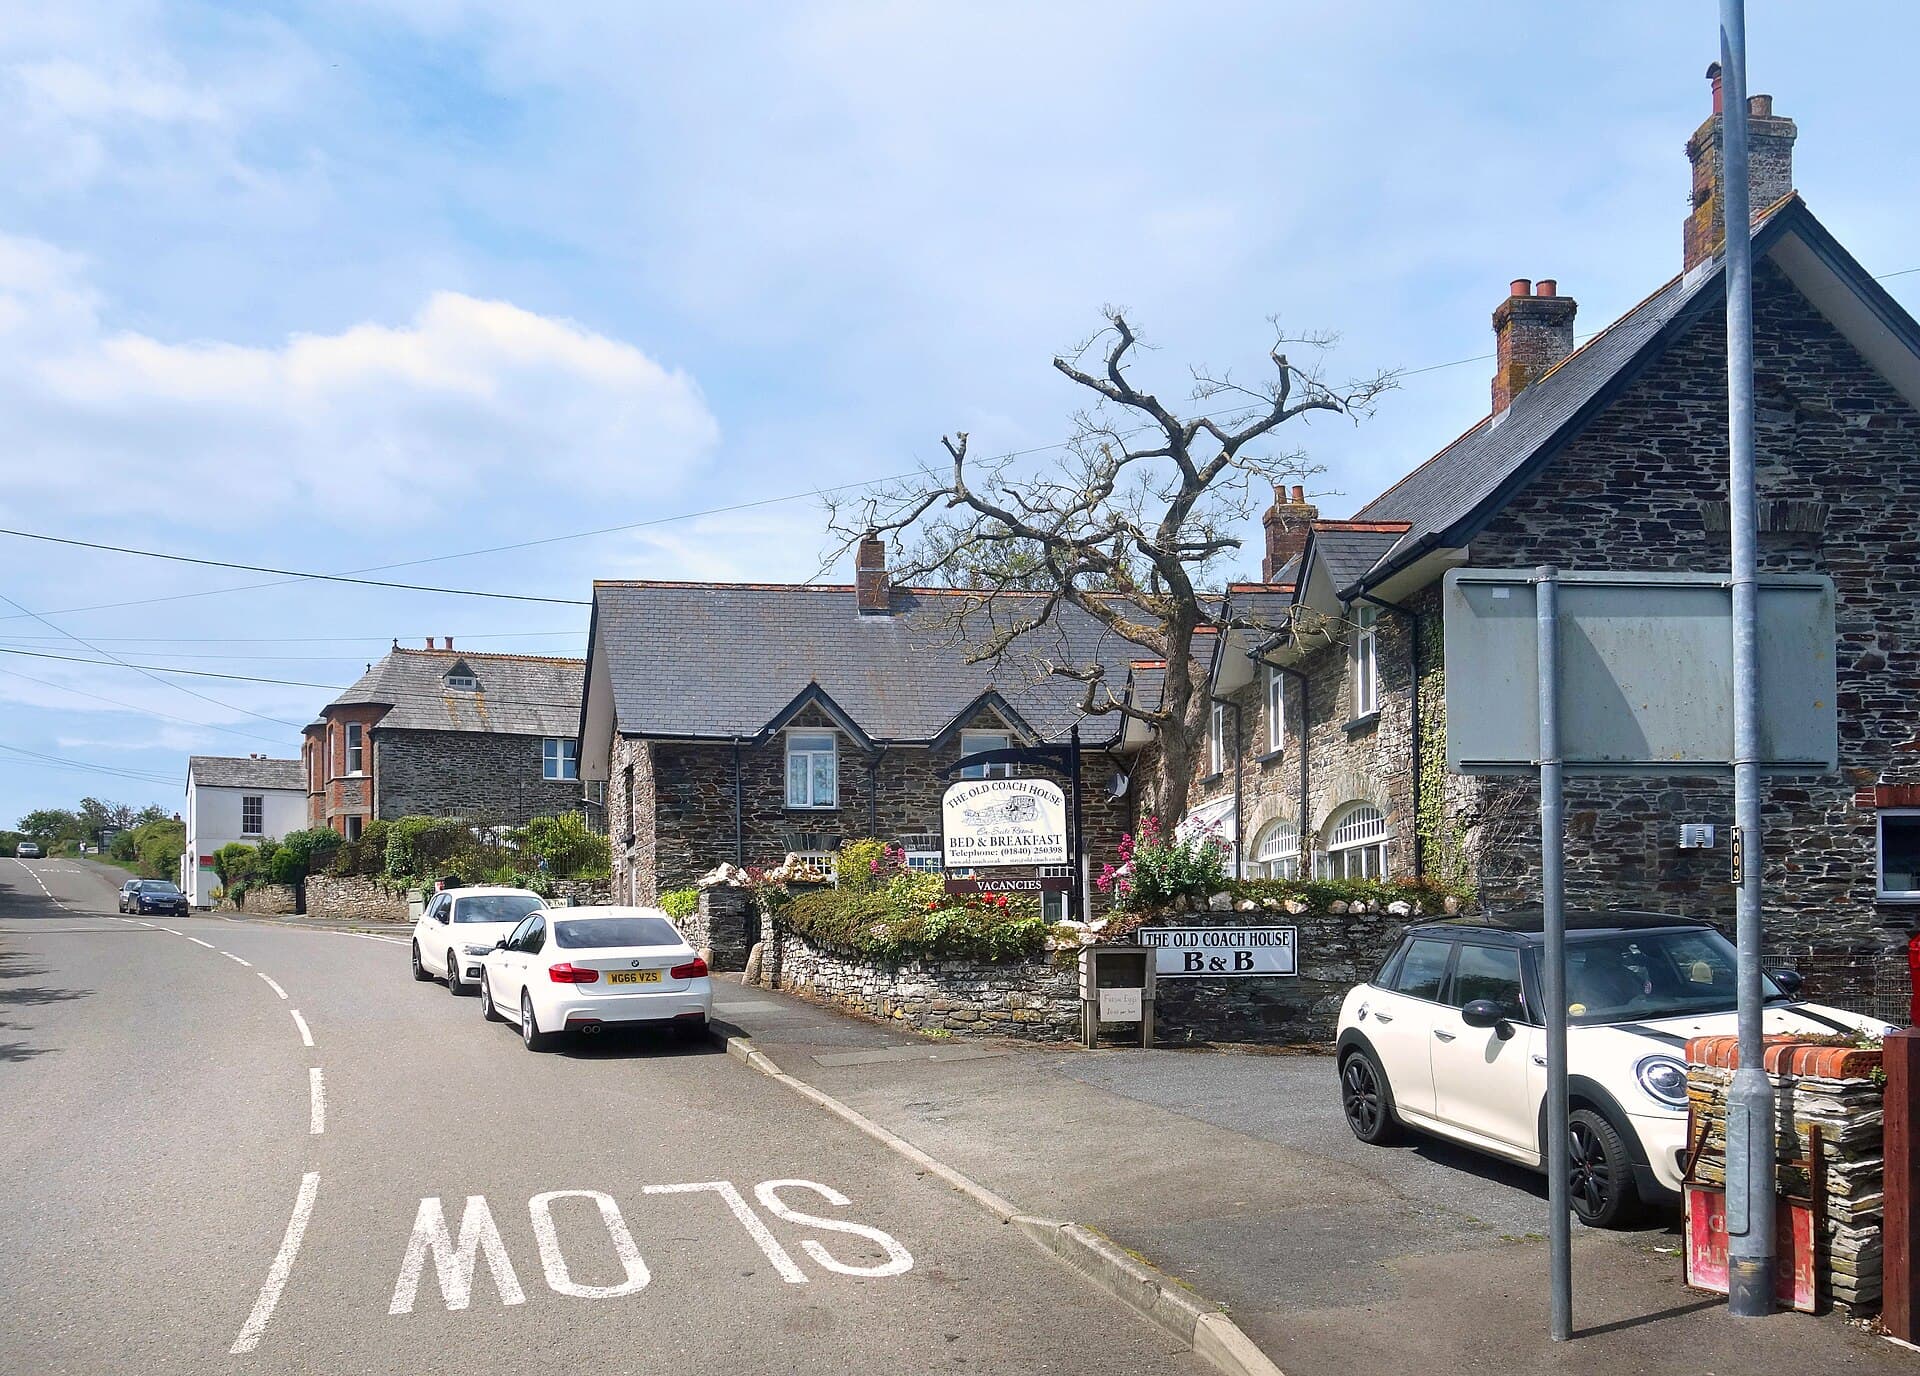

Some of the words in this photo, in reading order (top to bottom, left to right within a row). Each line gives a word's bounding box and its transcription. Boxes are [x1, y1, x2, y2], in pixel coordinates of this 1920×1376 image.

[947, 793, 968, 809] THE
[968, 785, 989, 798] OLD
[992, 782, 1027, 792] COACH
[1029, 785, 1063, 807] HOUSE
[950, 837, 975, 848] BED
[977, 837, 987, 847] &
[990, 834, 1063, 847] BREAKFAST
[950, 848, 998, 858] Telephone:
[1001, 846, 1031, 857] (01840)
[1034, 846, 1063, 855] 250398
[1732, 828, 1740, 880] H003
[977, 880, 1042, 891] VACANCIES
[1146, 933, 1169, 947] THE
[1173, 932, 1199, 947] OLD
[1203, 932, 1246, 947] COACH
[1249, 931, 1290, 946] HOUSE
[1183, 951, 1205, 972] B
[1208, 957, 1227, 971] &
[1233, 950, 1255, 971] B
[611, 973, 637, 983] WG66
[639, 972, 658, 982] VZS
[389, 1179, 914, 1315] SLOW
